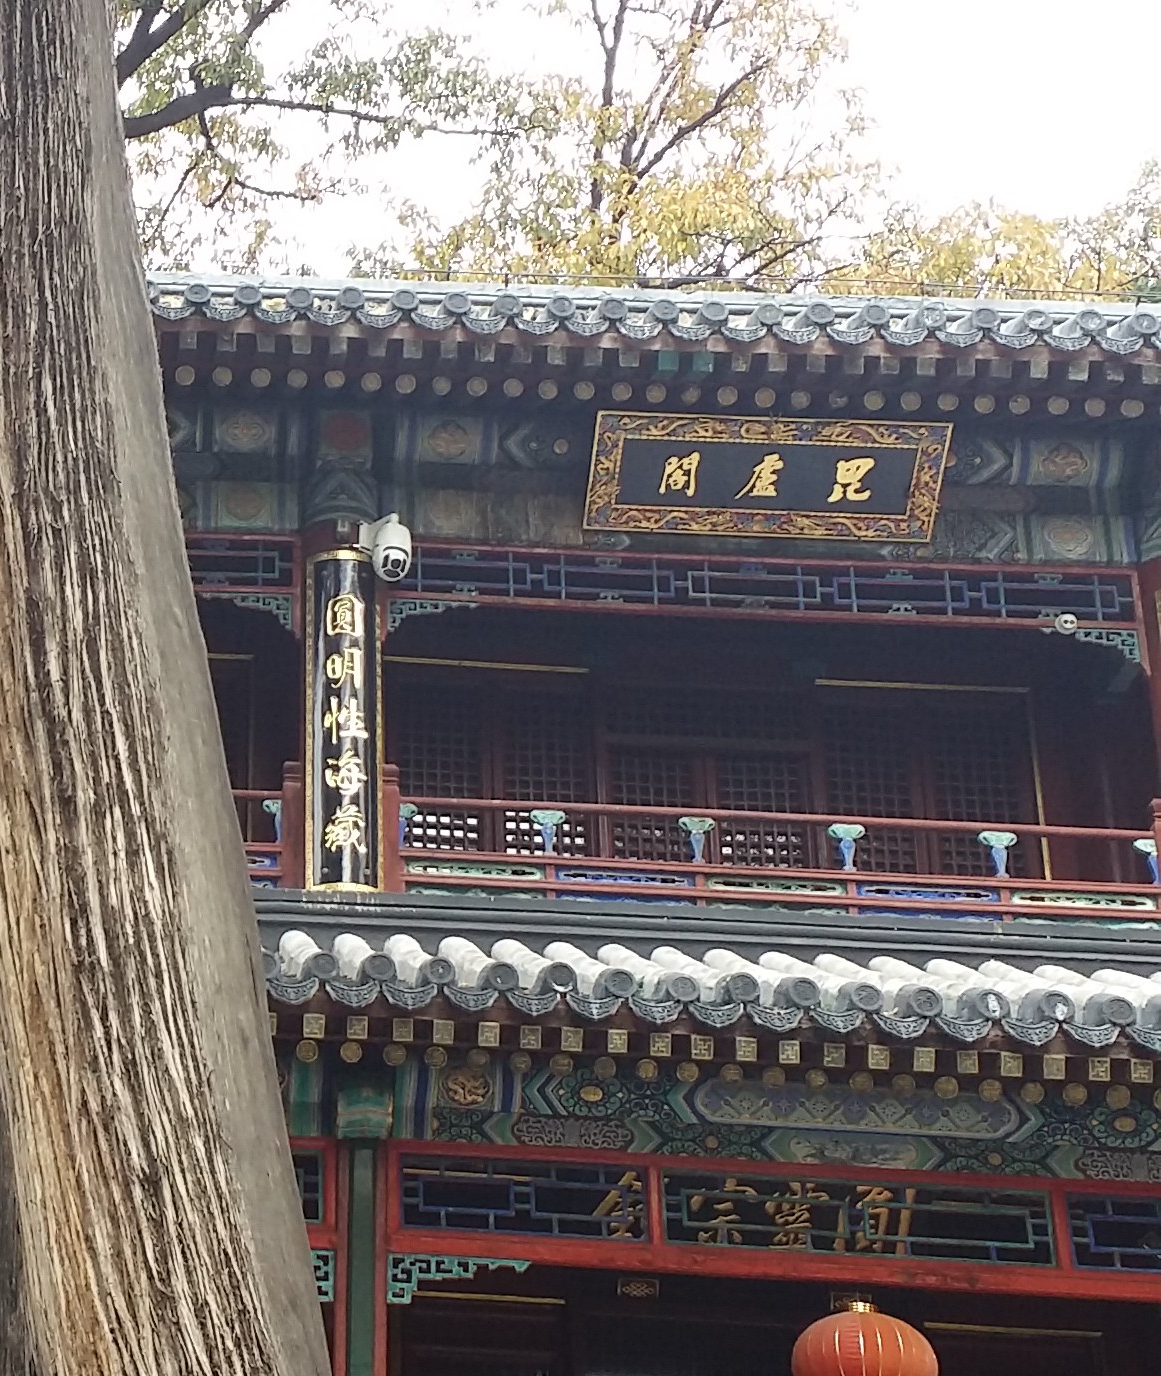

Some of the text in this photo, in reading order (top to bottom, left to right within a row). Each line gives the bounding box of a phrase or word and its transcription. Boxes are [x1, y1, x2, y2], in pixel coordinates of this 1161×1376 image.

[323, 591, 369, 853] 圓明性海藏
